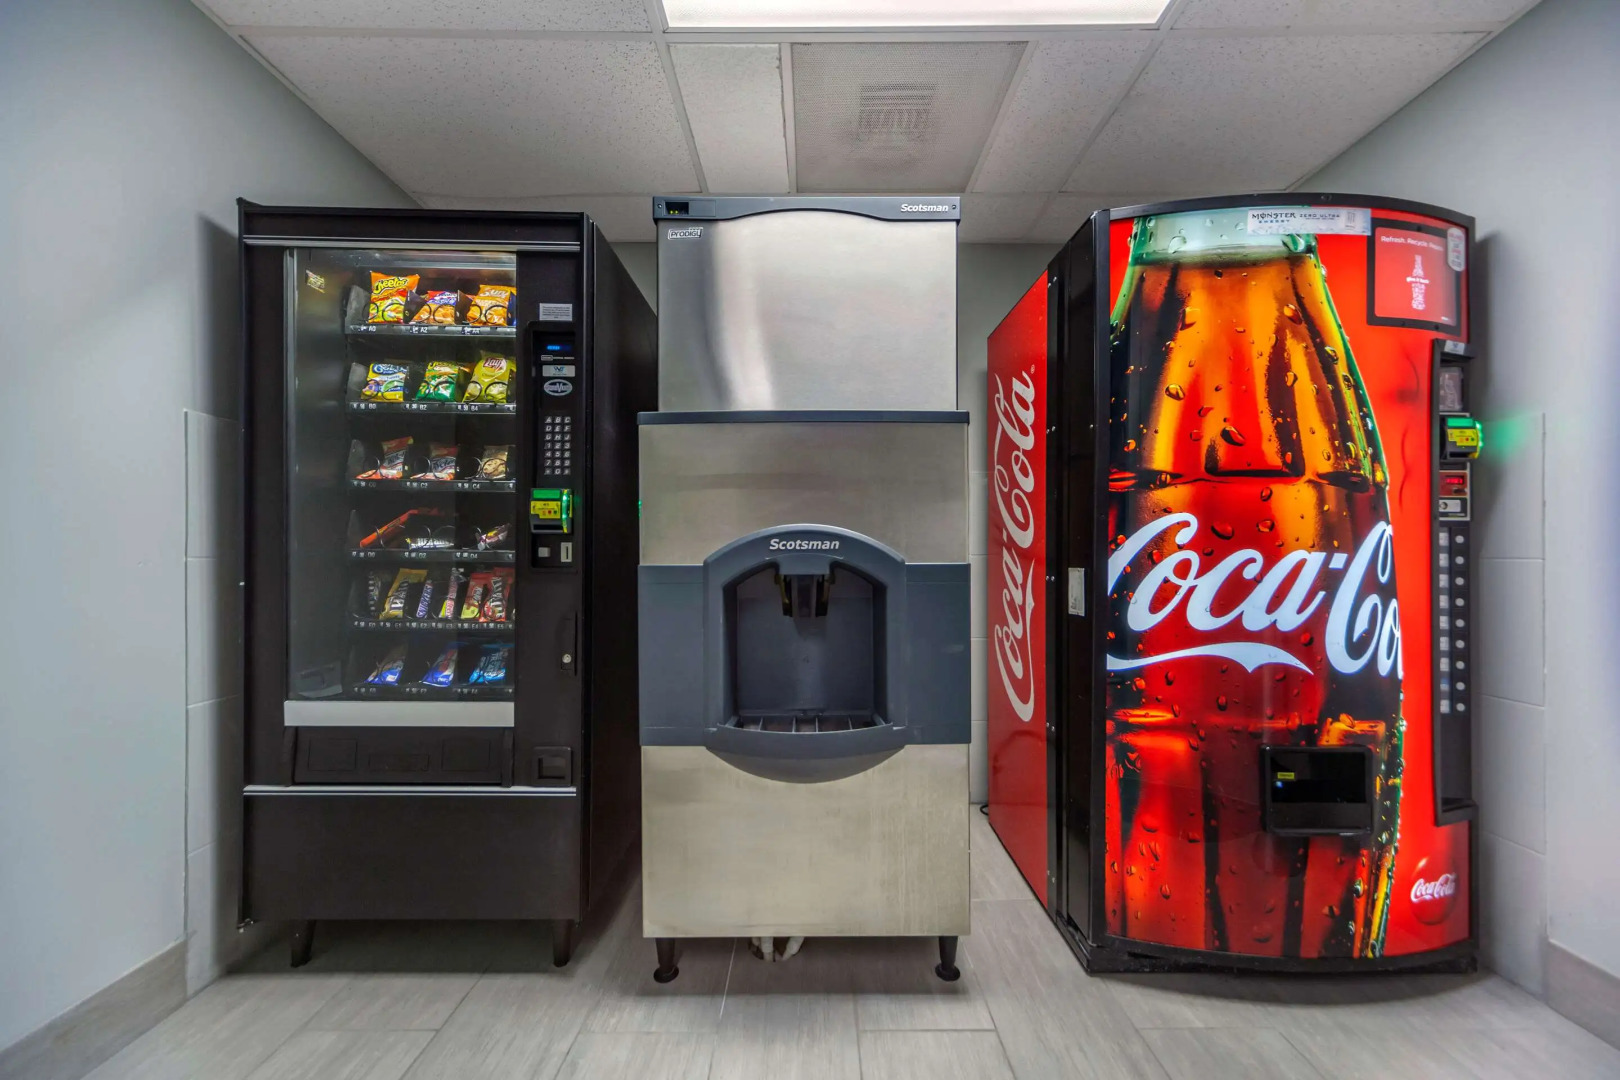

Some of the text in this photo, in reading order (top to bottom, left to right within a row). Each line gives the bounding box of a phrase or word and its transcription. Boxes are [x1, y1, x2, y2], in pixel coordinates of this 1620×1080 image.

[900, 203, 949, 212] Scotsman
[373, 277, 408, 294] Cheetos
[769, 538, 840, 551] Scotsman
[993, 370, 1036, 722] Coca-Cola
